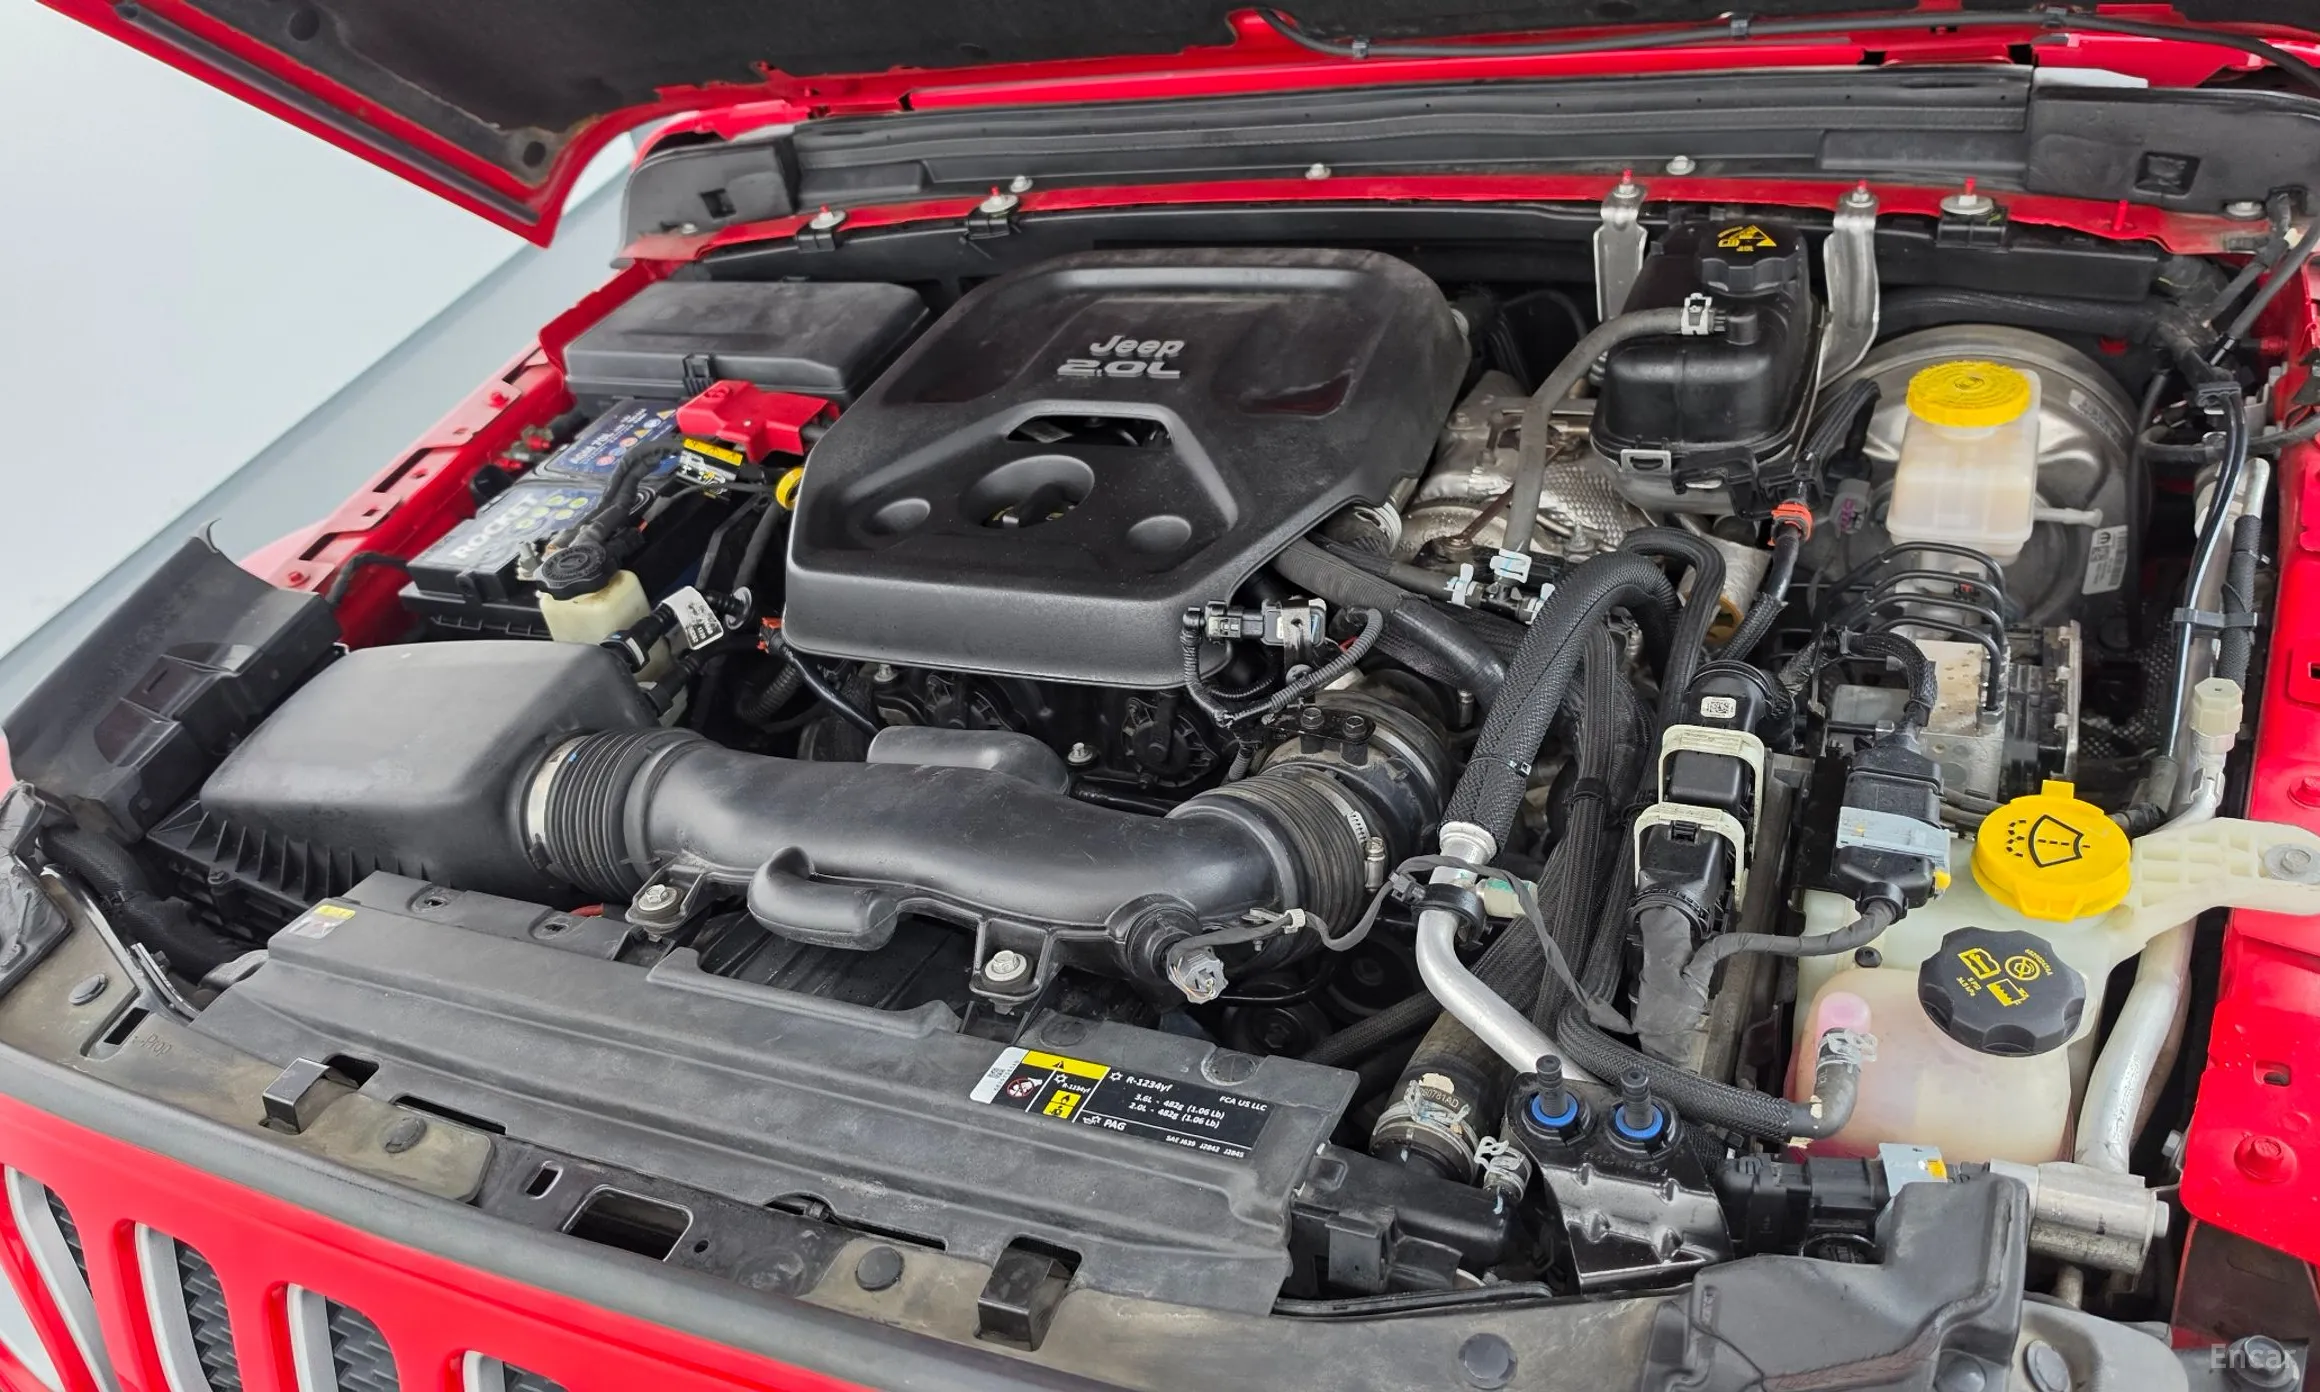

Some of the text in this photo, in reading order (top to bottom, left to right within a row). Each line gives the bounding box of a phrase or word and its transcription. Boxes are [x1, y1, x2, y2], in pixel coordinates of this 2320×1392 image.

[1089, 335, 1185, 359] Jeep
[1057, 359, 1181, 379] 2.0L
[450, 492, 538, 559] ROCKET
[1126, 1076, 1173, 1092] R-1234yf
[1134, 1093, 1152, 1103] 3.6L
[1163, 1099, 1184, 1111] 482g
[1187, 1105, 1210, 1116] (1.06
[1211, 1109, 1225, 1120] Lb)
[1219, 1095, 1268, 1112] FCA US LLC
[1103, 1118, 1127, 1131] PAG
[1128, 1102, 1147, 1112] 2.0L
[1157, 1108, 1179, 1120] 482g
[1181, 1113, 1205, 1125] (1.06
[1205, 1118, 1220, 1129] Lb)
[1165, 1135, 1180, 1143] SAE
[1180, 1138, 1196, 1147] J639
